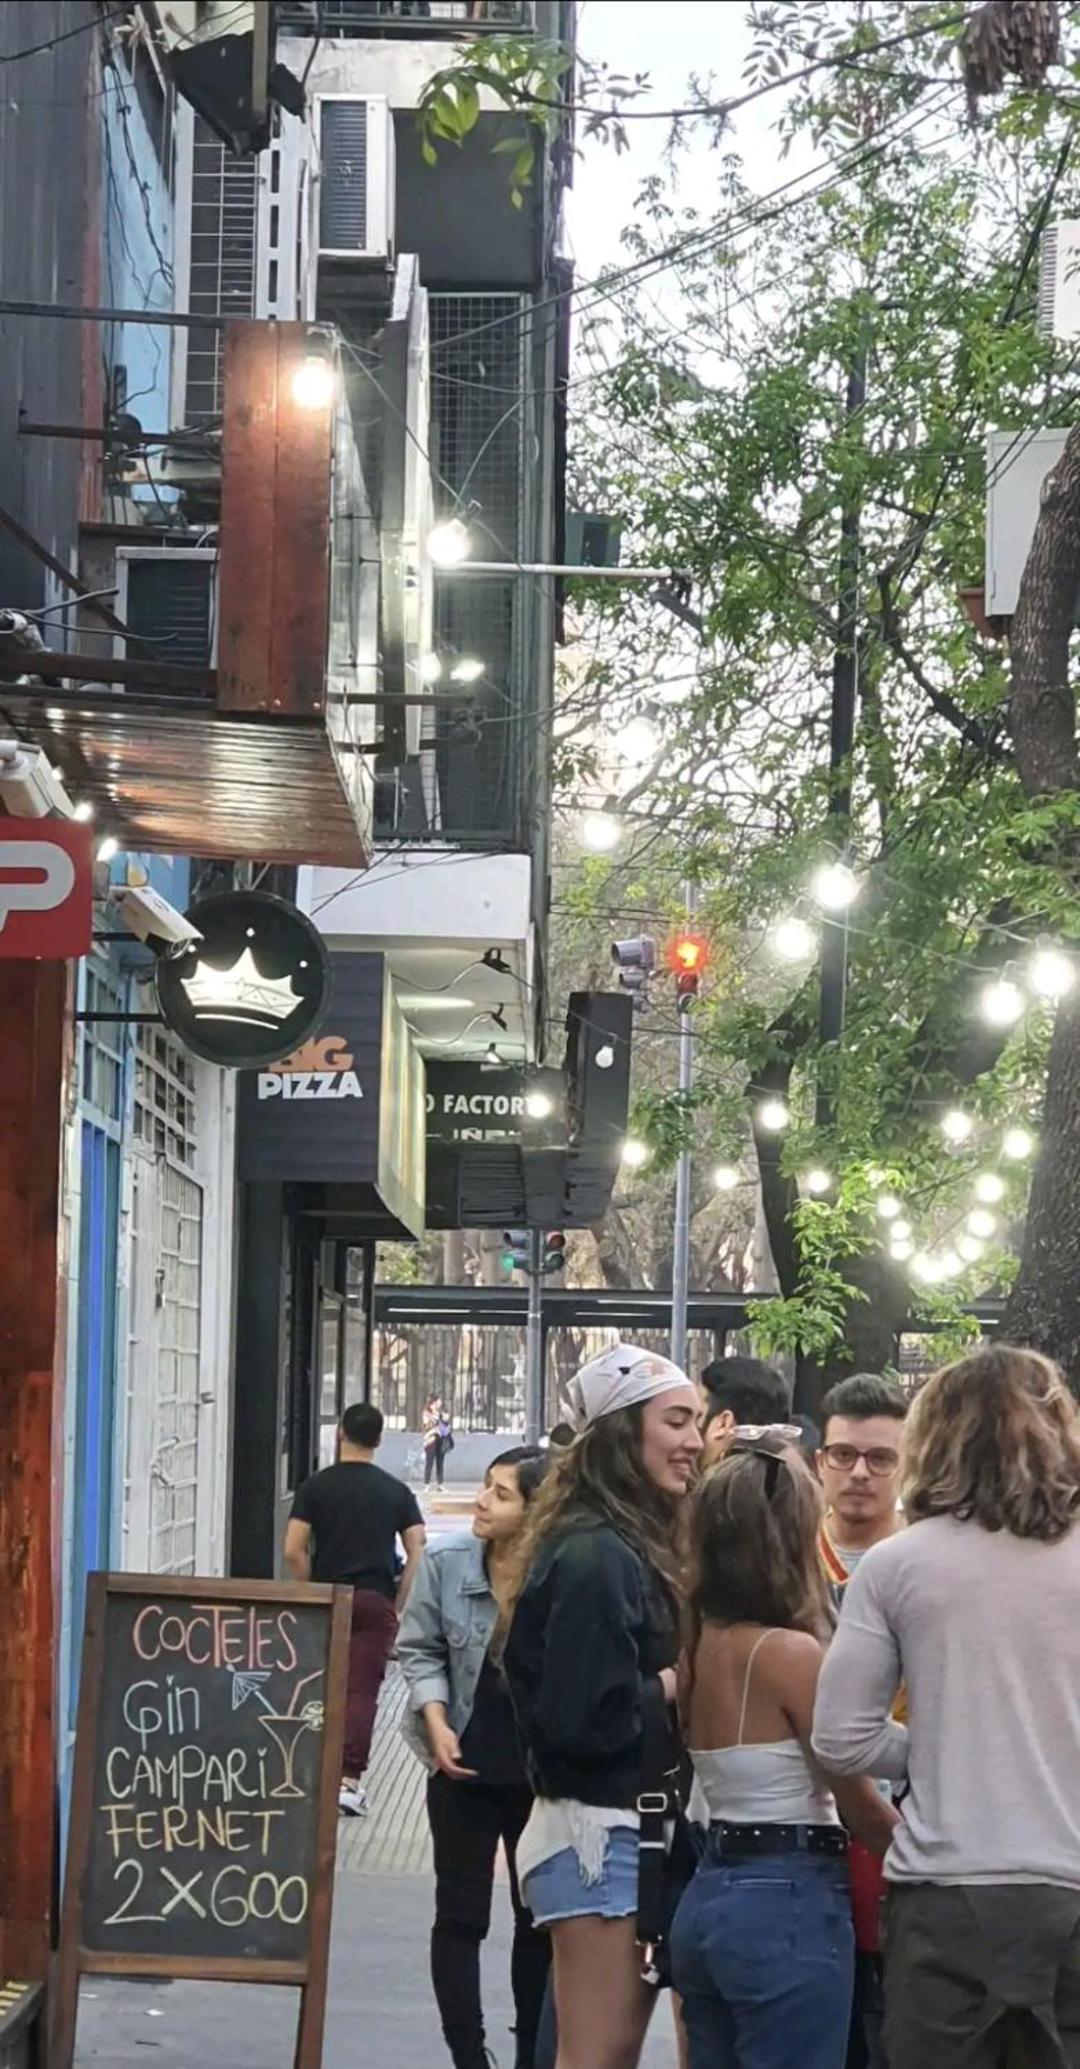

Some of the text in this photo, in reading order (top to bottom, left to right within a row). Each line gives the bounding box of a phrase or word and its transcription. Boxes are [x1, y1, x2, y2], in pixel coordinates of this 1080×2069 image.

[258, 1071, 364, 1100] PIZZA
[123, 1674, 200, 1751] Gin
[100, 1804, 286, 1858] FERNET
